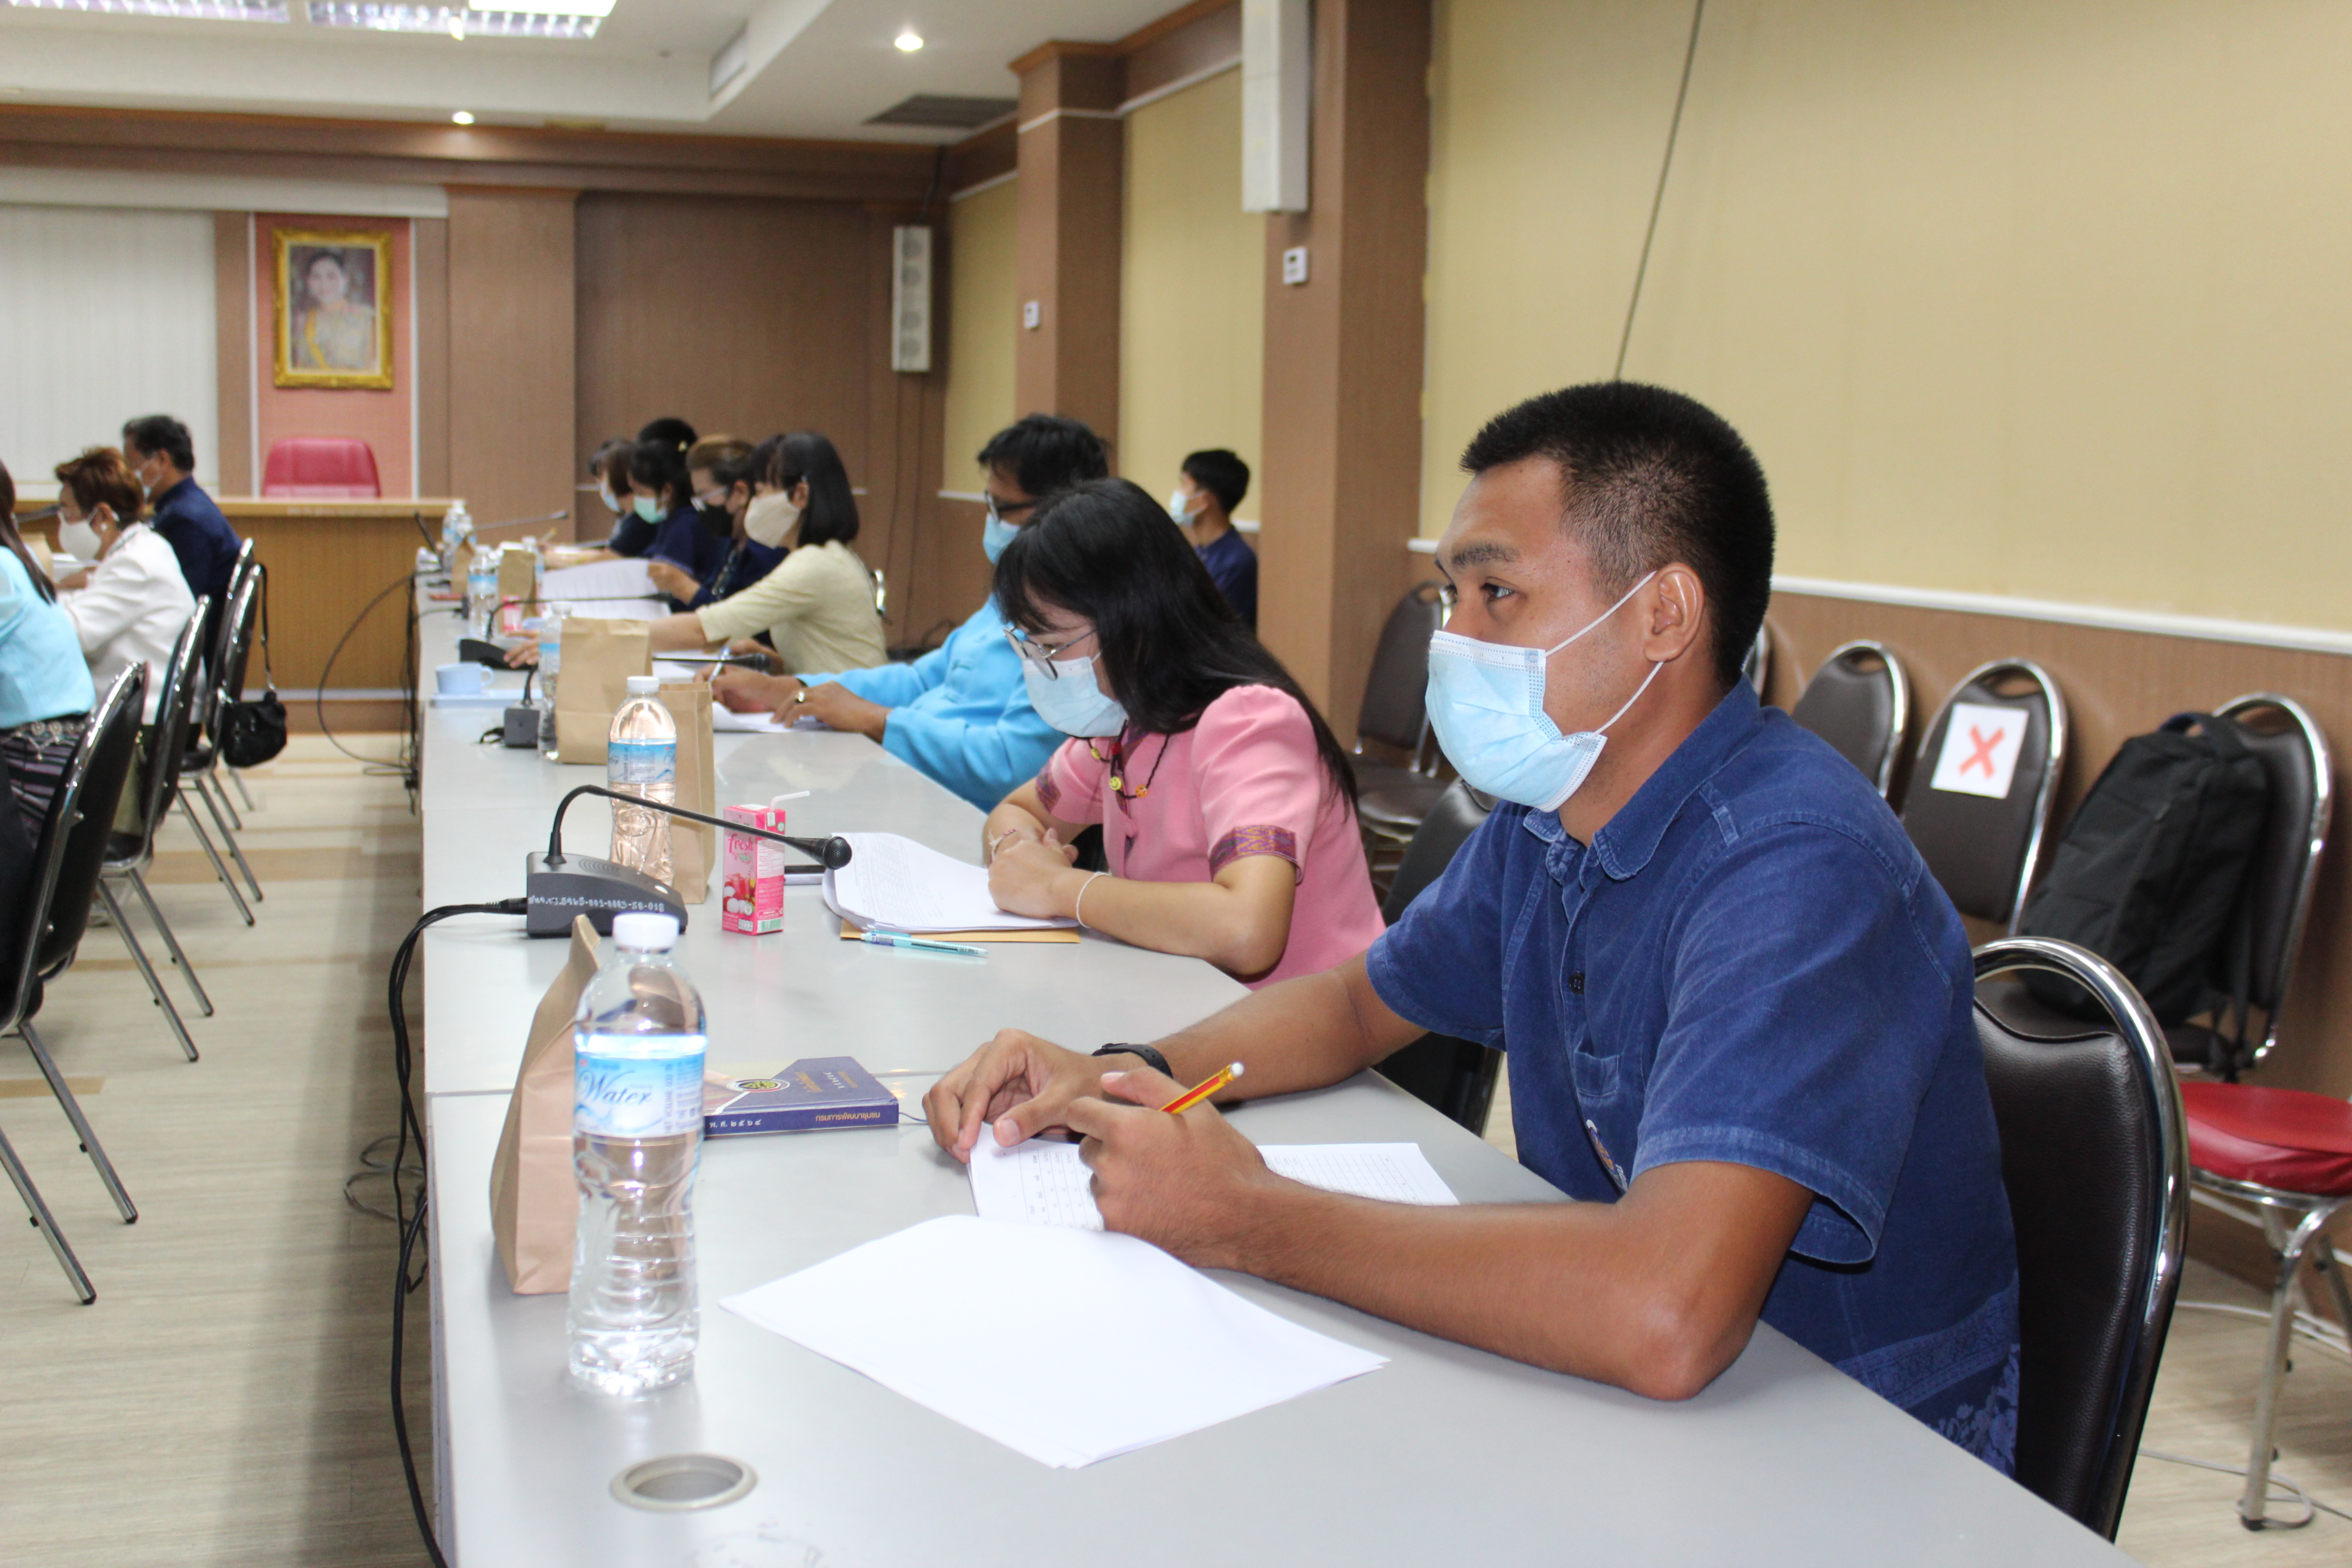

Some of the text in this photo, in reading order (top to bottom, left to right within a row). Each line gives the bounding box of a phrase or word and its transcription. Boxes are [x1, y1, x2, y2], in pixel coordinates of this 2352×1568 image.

[728, 833, 753, 853] fresh
[577, 1070, 652, 1106] Water
[664, 1091, 672, 1118] VOLUME
[815, 1112, 881, 1122] กรมการพัฒนาชุมชน
